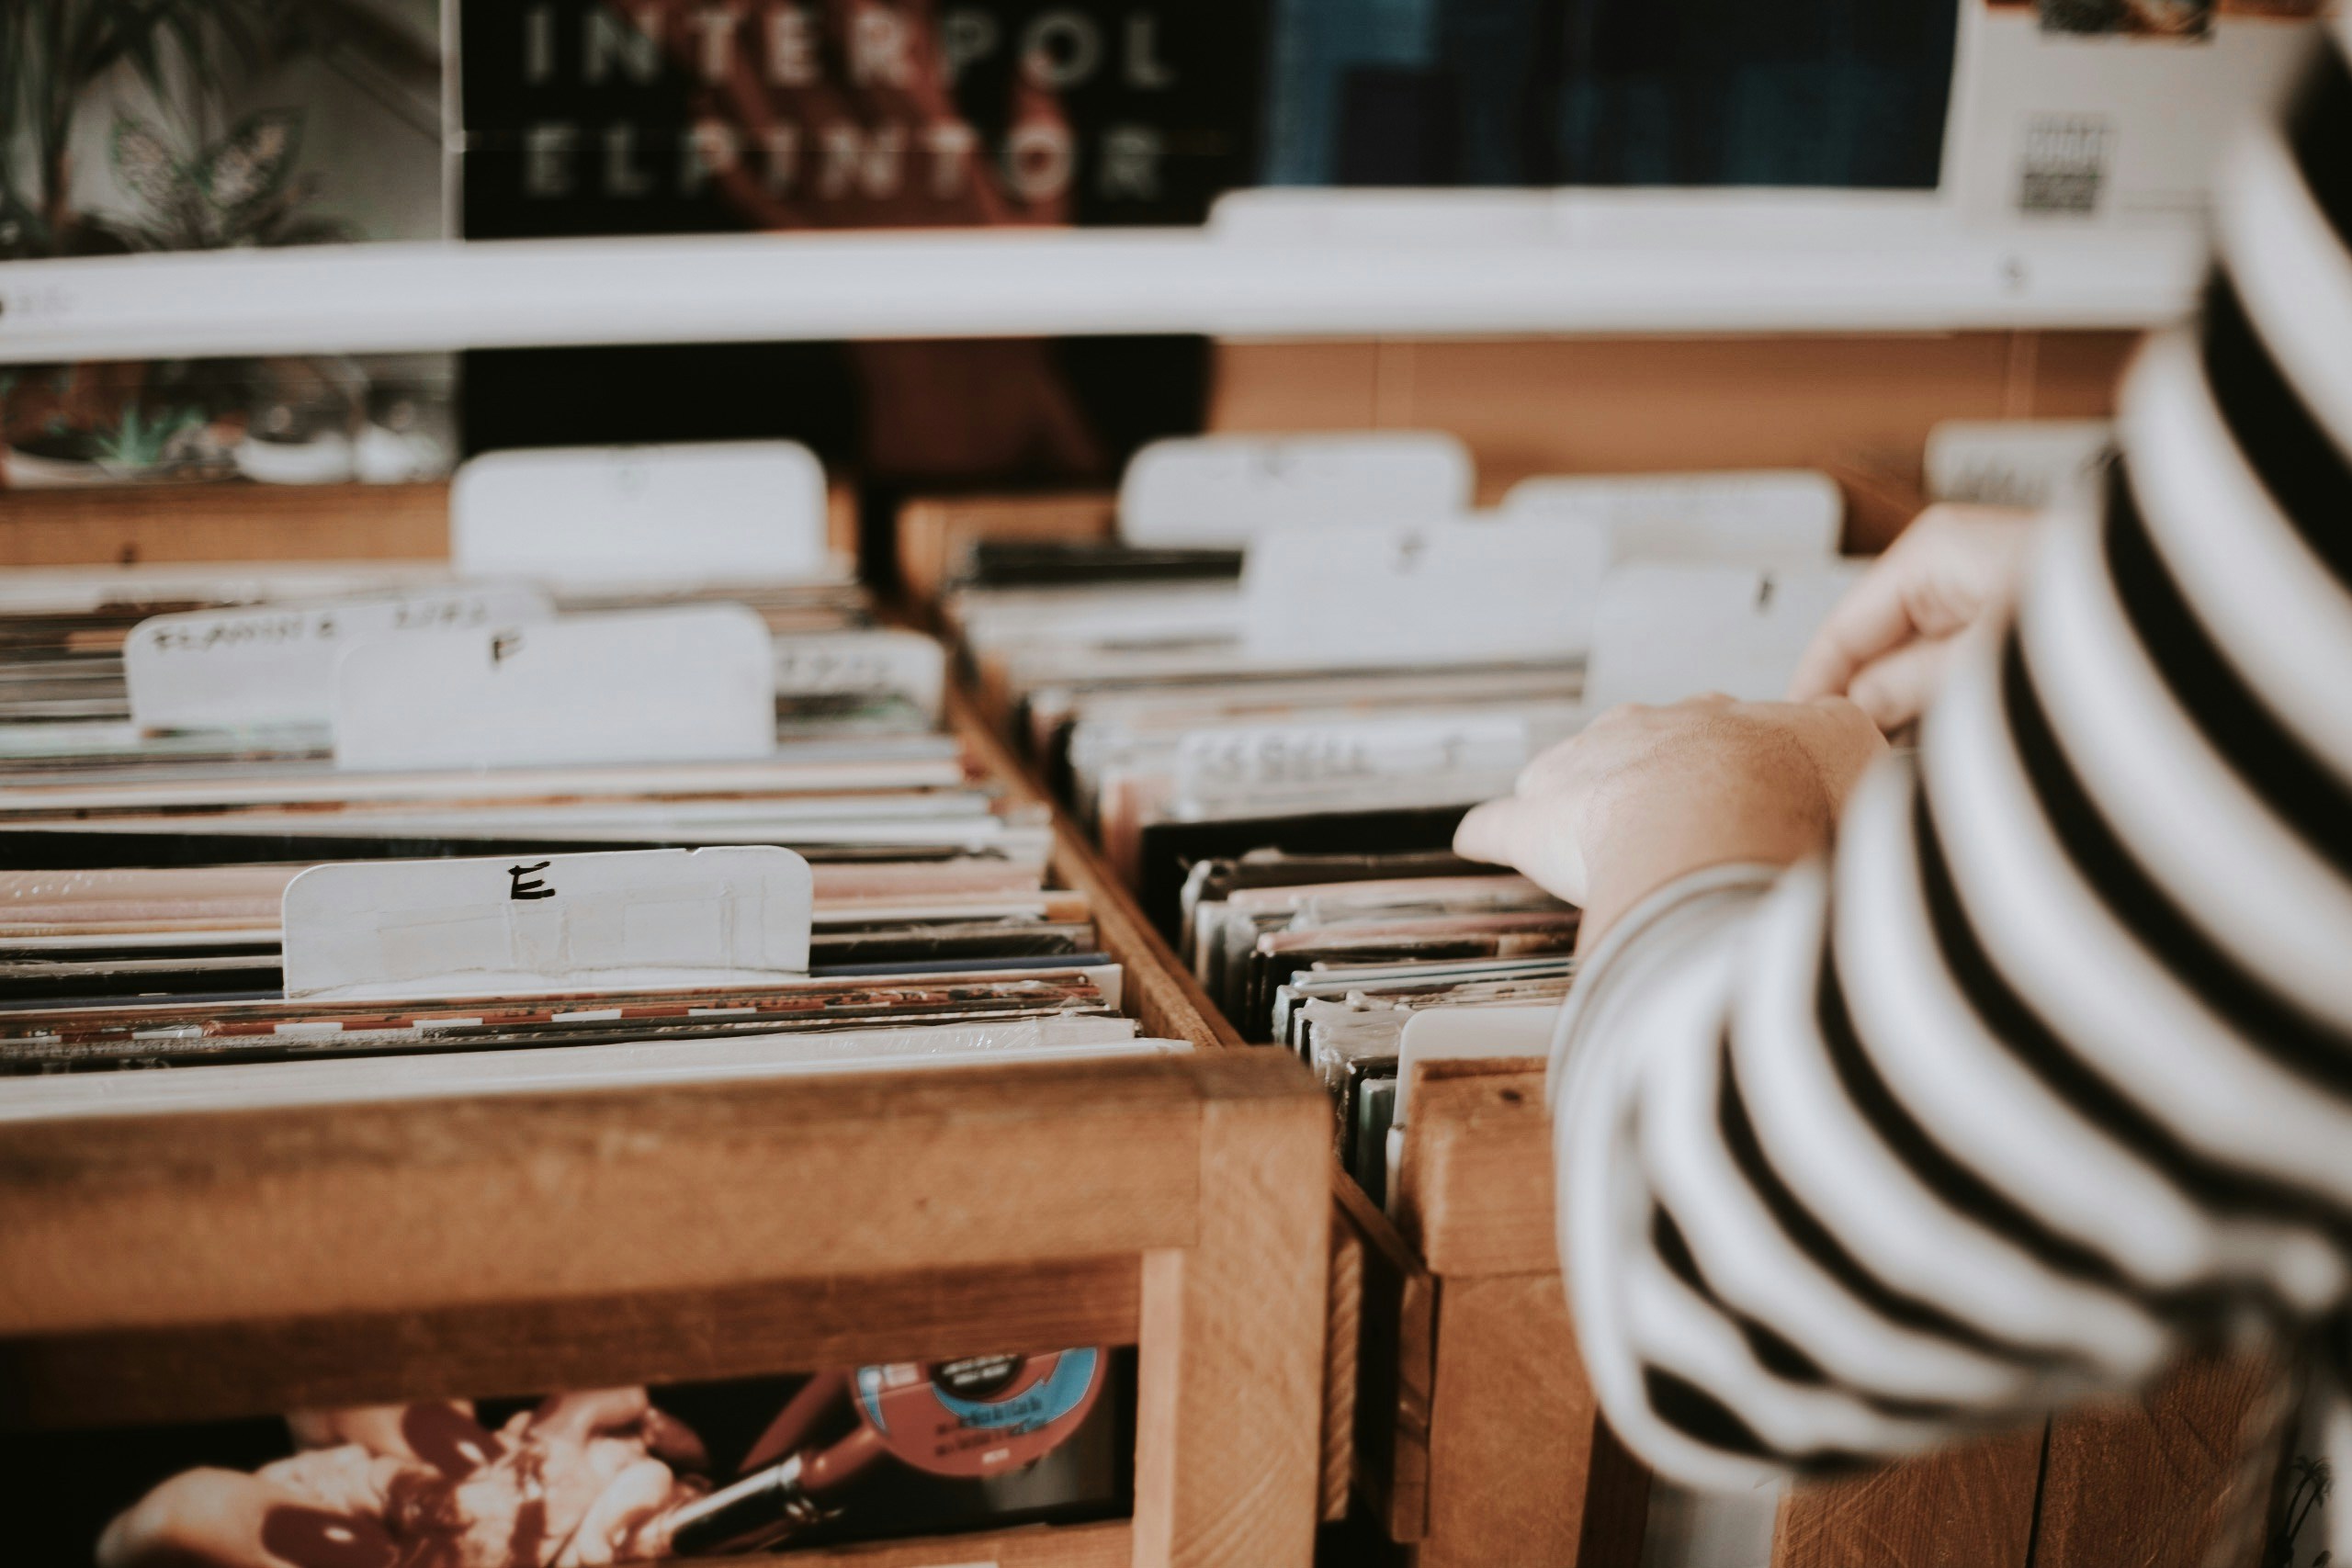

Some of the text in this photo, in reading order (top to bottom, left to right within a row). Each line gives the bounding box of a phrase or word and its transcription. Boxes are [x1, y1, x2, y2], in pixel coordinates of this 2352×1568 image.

[524, 13, 1176, 85] INTERPOL
[489, 628, 522, 668] F
[507, 861, 556, 900] E
